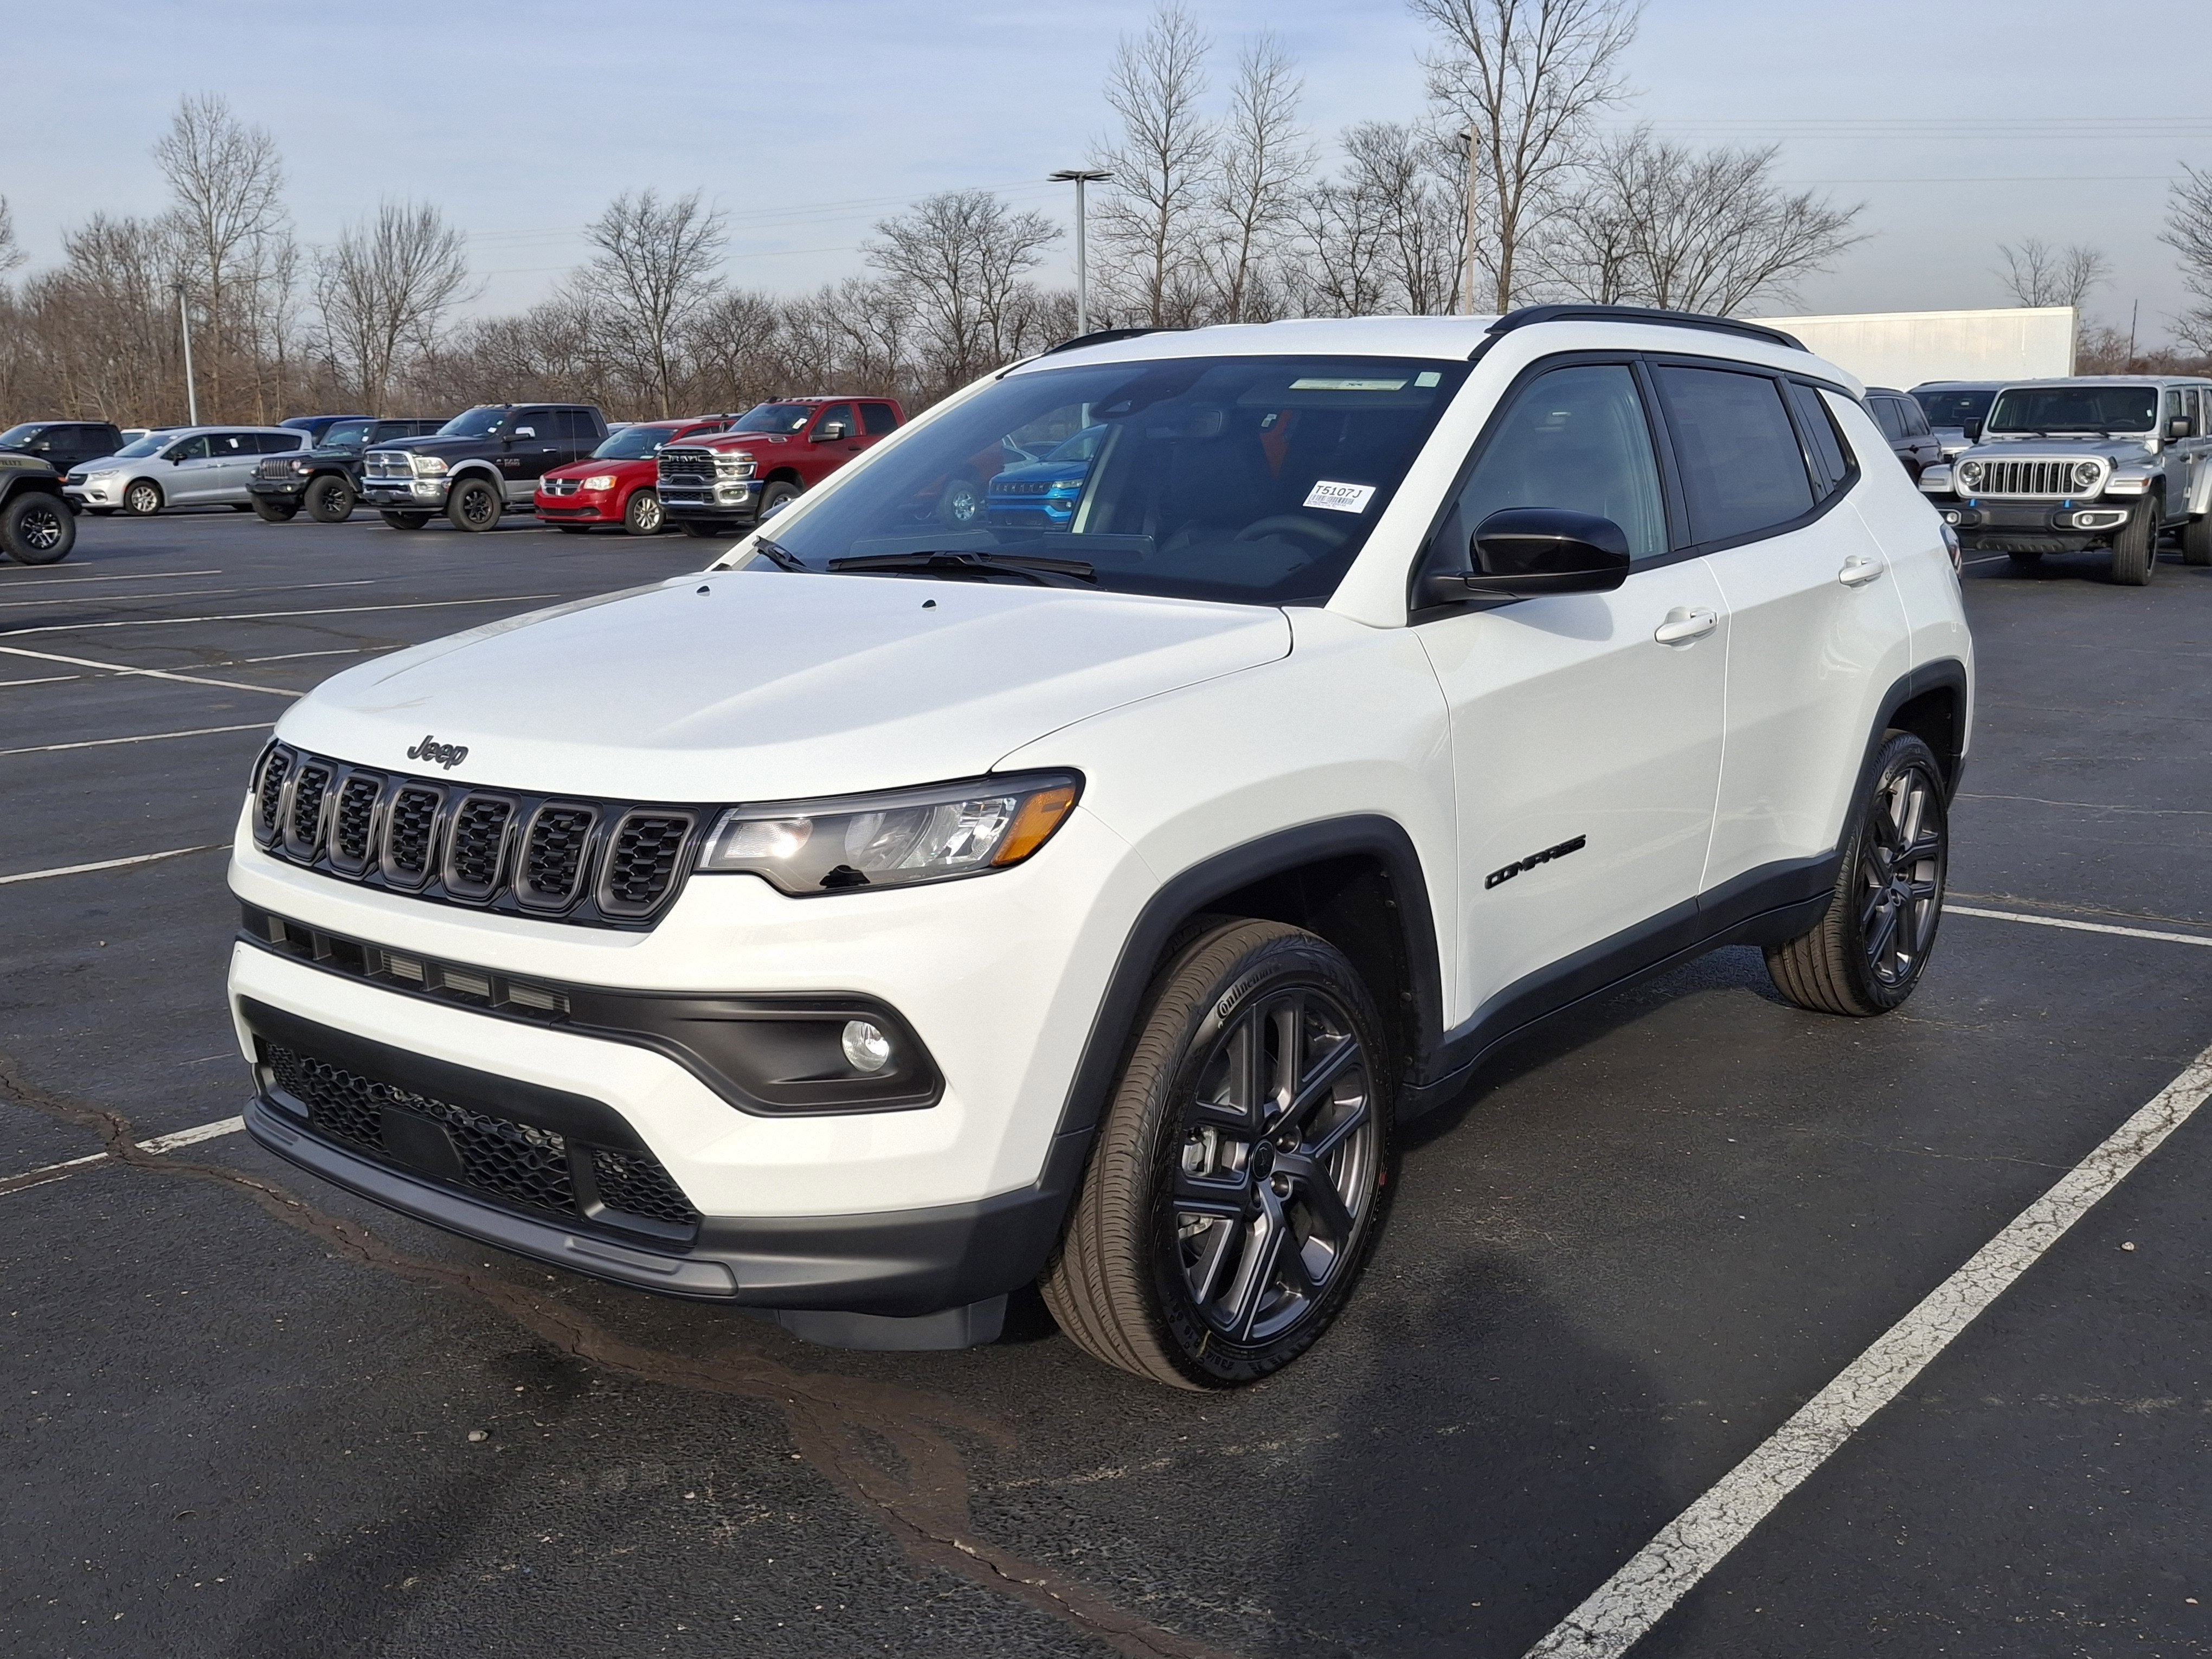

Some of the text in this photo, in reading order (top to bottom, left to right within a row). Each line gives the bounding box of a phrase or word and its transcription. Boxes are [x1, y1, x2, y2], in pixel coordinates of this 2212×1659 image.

[671, 454, 698, 463] RAM
[1316, 485, 1363, 498] T5107J
[407, 735, 469, 771] Jeep
[1484, 833, 1586, 890] COMPASS
